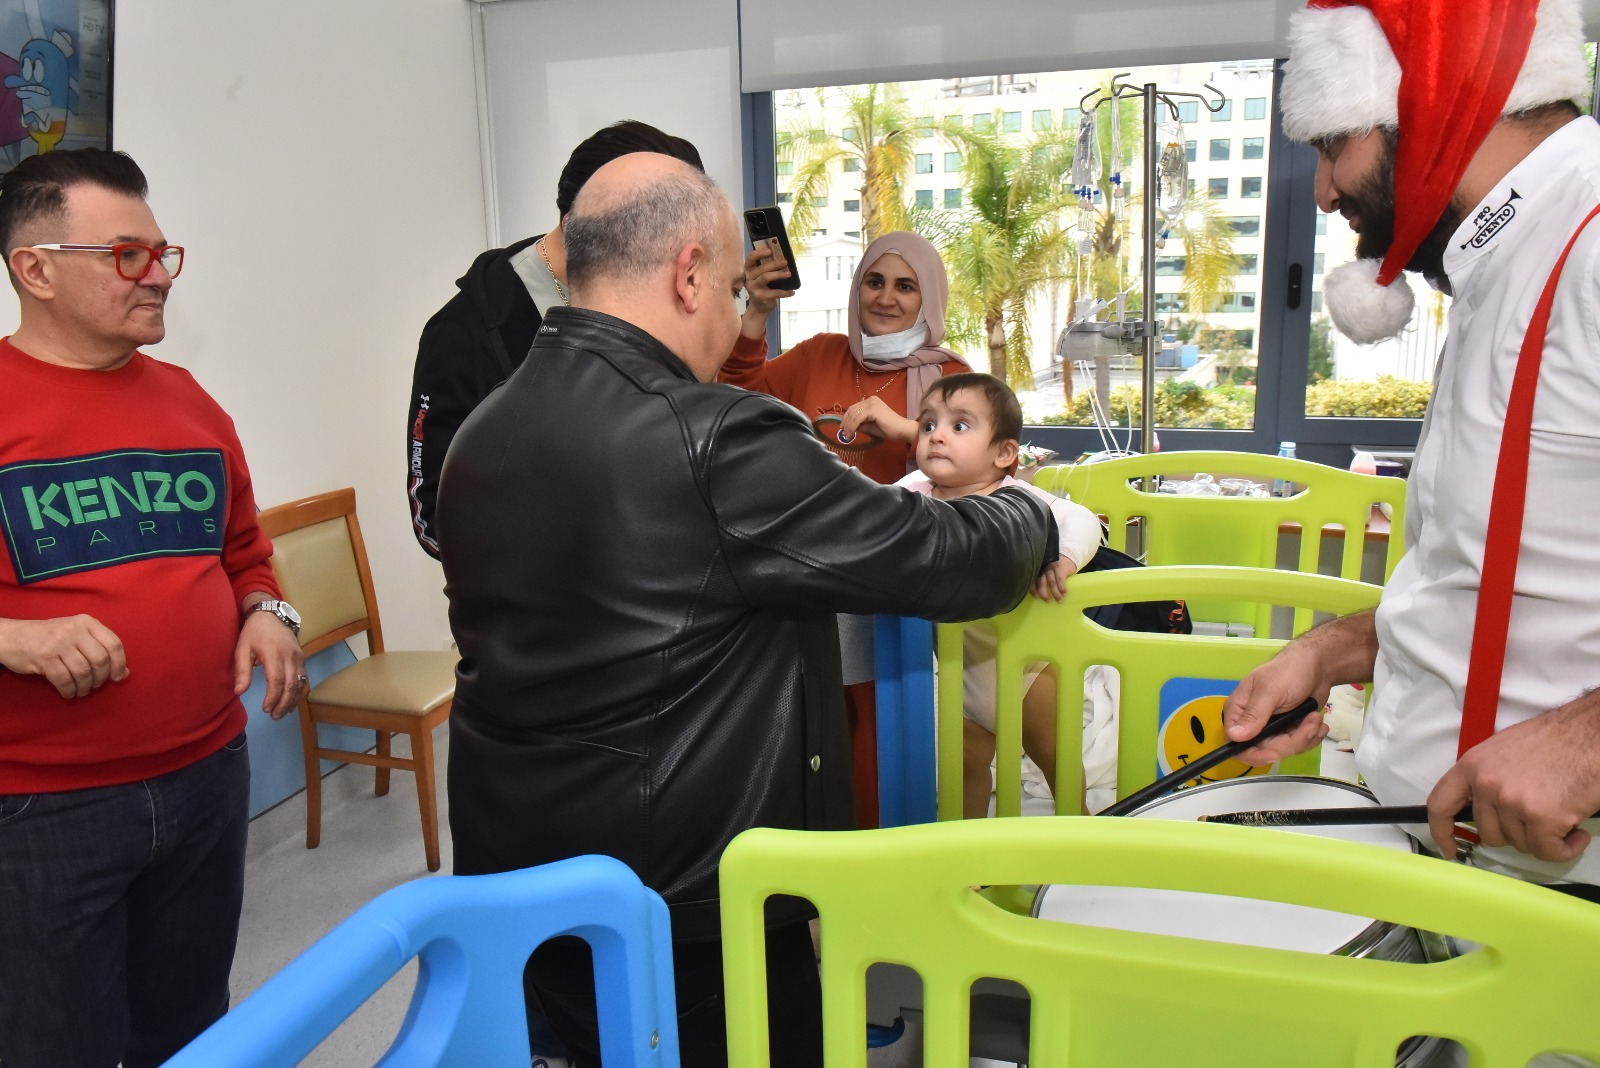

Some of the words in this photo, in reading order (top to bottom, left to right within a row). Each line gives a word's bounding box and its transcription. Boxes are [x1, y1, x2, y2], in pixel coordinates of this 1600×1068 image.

[1473, 206, 1491, 227] PRO
[1474, 208, 1511, 245] EVENTO
[411, 439, 423, 477] ARMOUR
[21, 470, 216, 531] KENZO
[35, 518, 216, 555] PARIS
